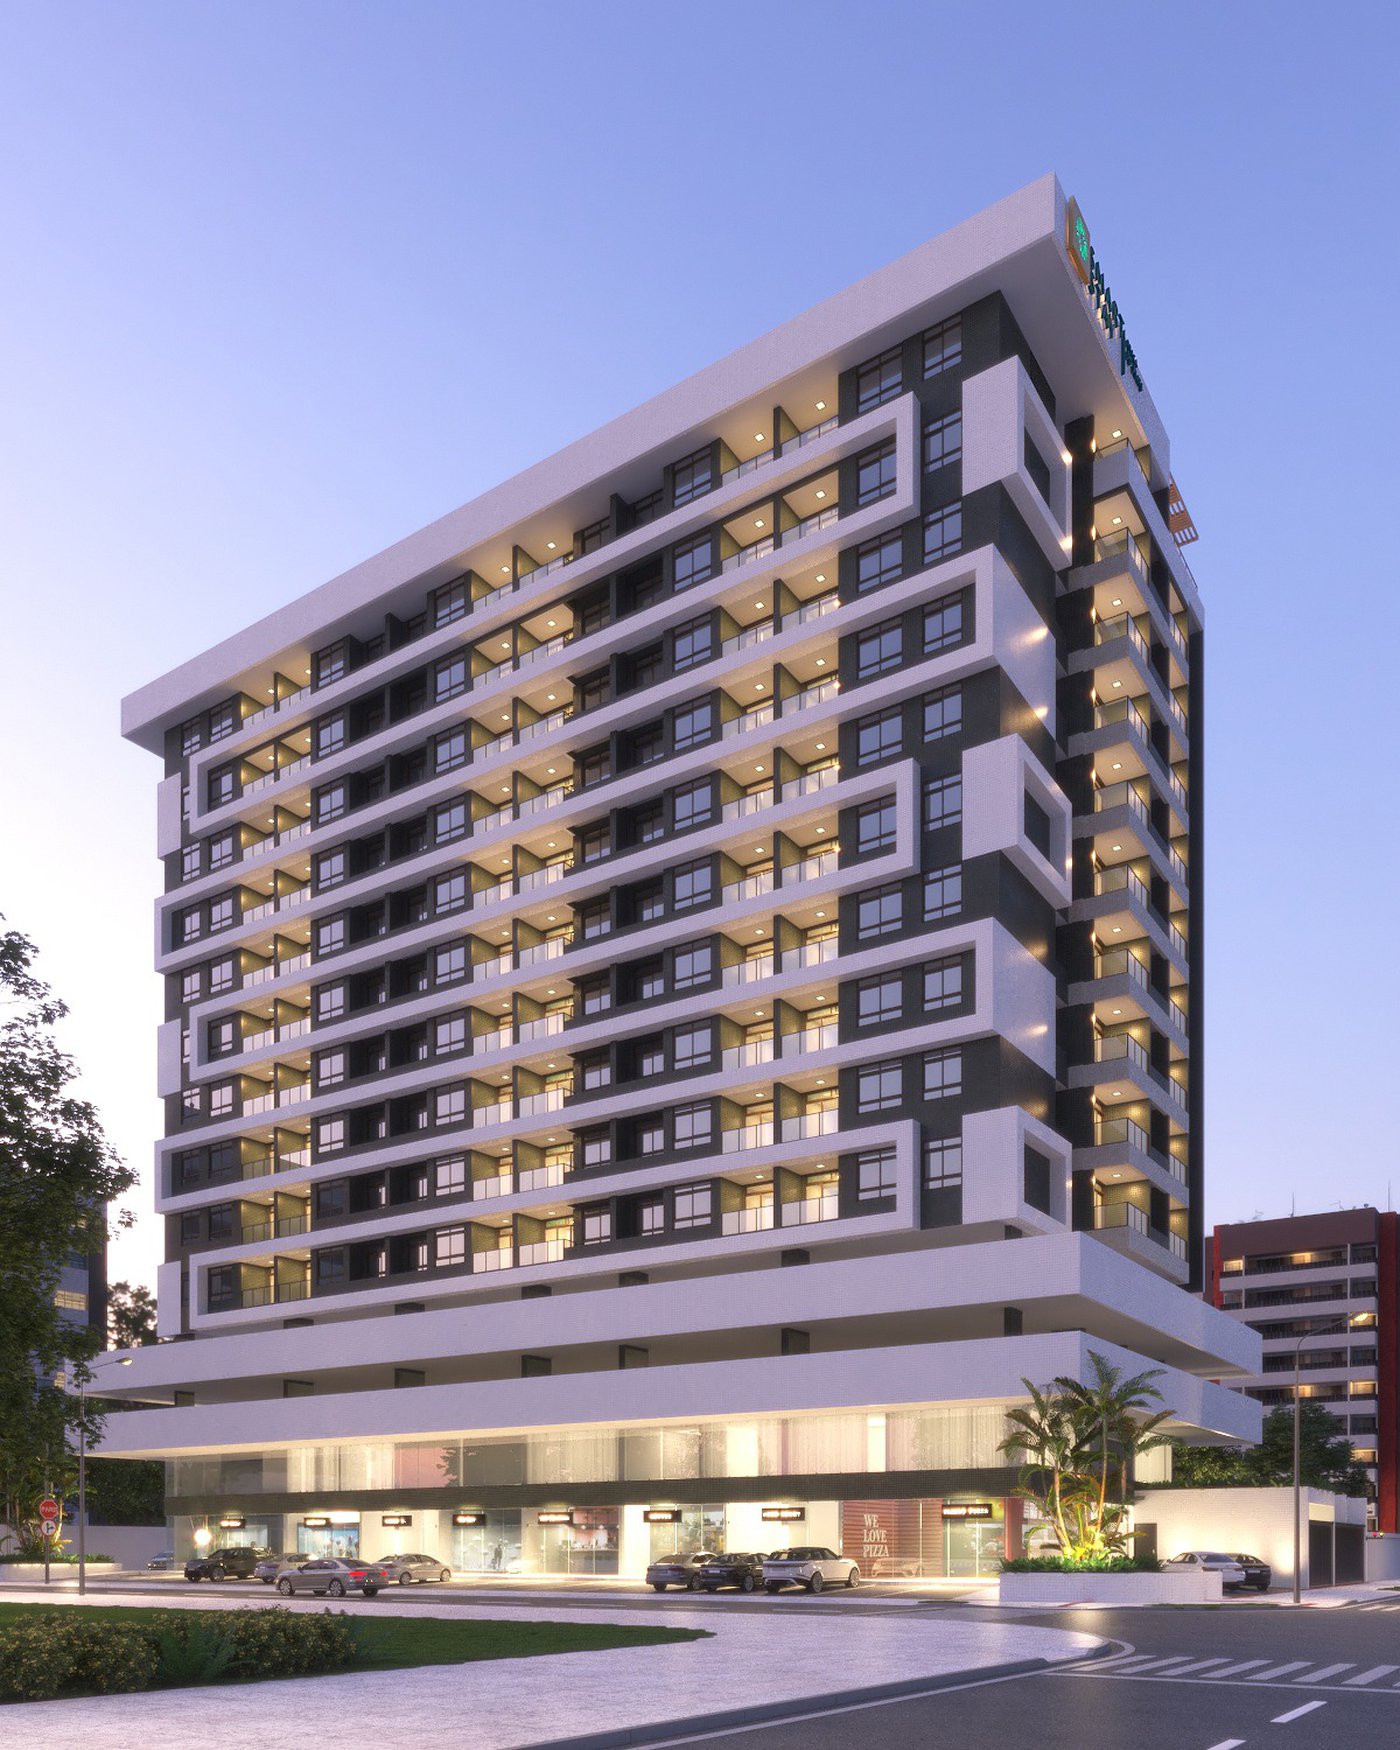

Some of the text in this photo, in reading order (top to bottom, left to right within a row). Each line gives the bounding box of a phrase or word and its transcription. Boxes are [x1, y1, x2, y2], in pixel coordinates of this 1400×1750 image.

[863, 1513, 879, 1528] WE
[863, 1529, 888, 1543] LOVE
[863, 1544, 889, 1558] PIZZA
